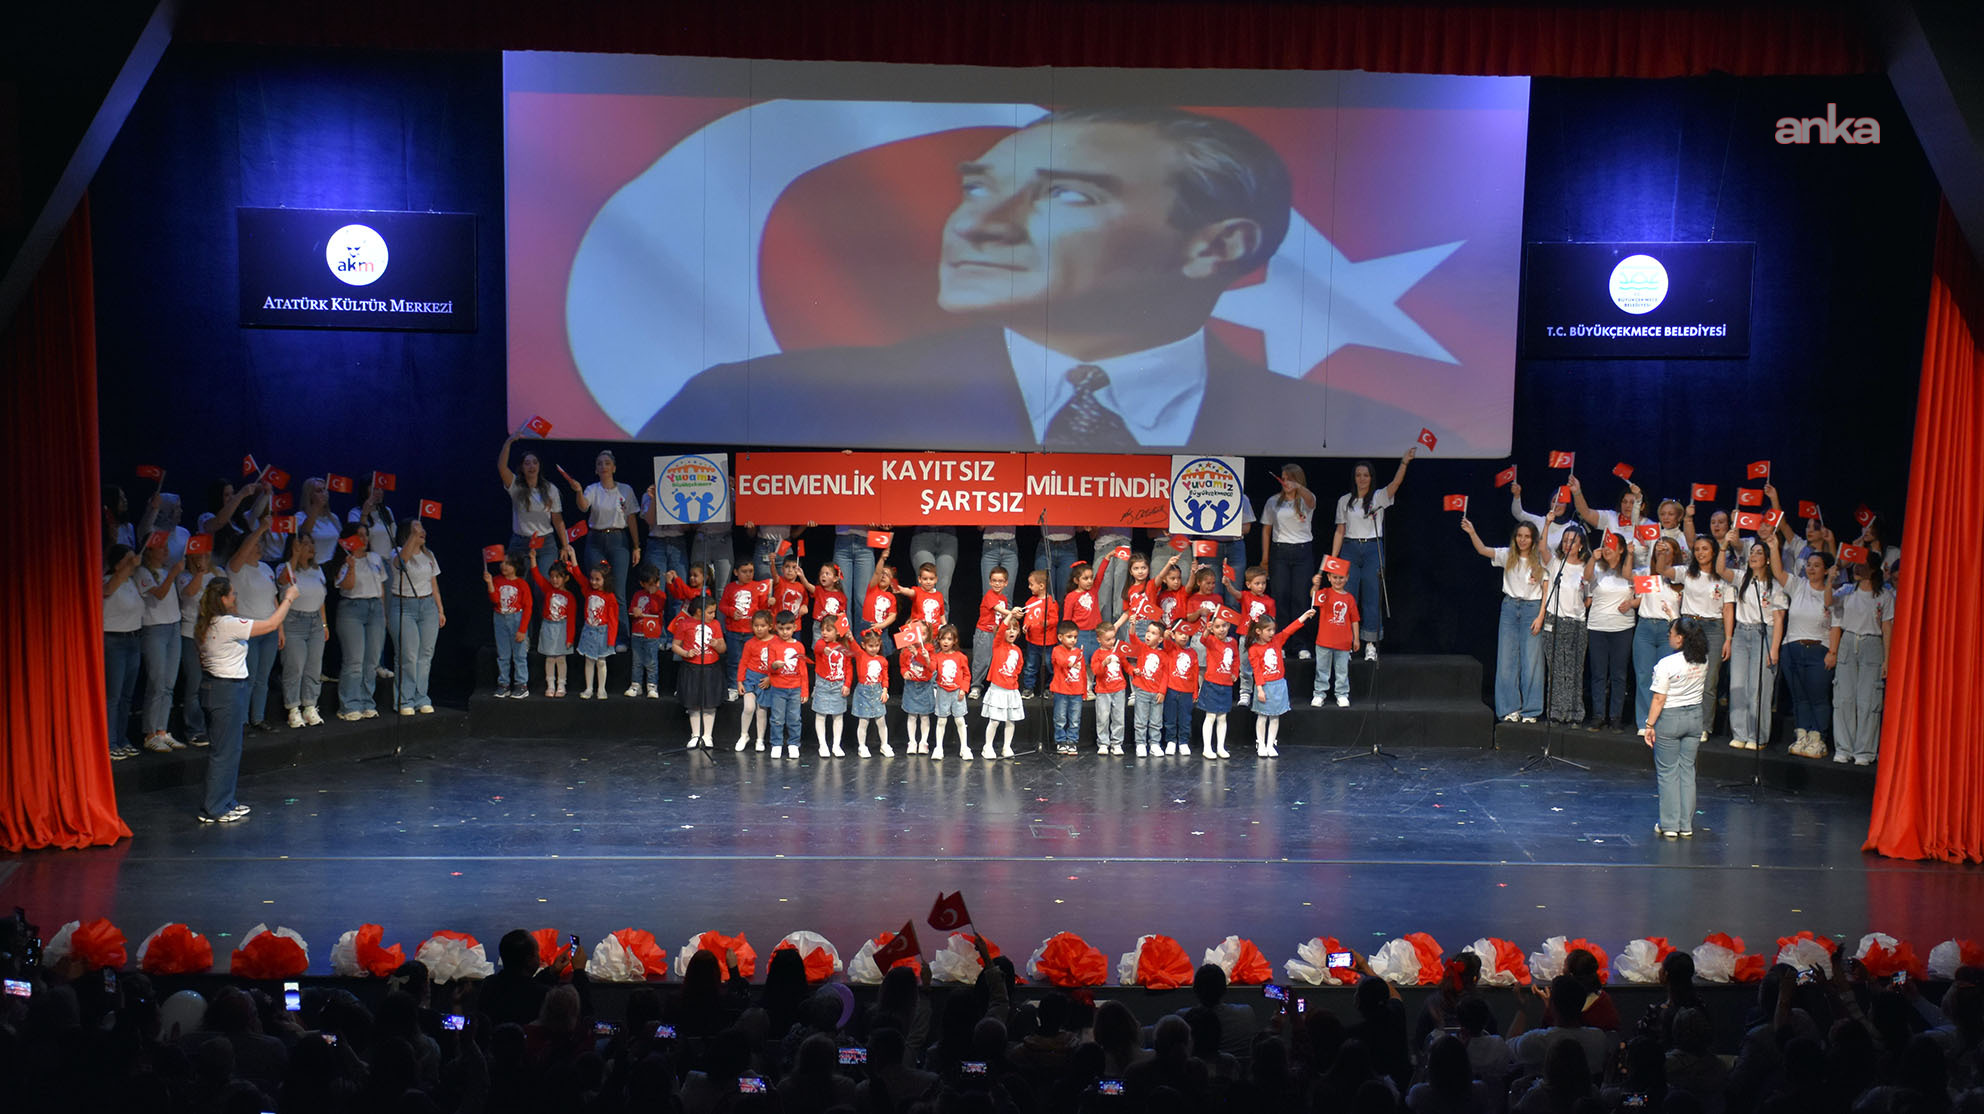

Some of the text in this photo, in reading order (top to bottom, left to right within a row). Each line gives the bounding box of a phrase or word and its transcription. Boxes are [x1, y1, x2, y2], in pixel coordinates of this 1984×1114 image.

[337, 258, 374, 272] akm
[263, 296, 453, 314] ATATÜRK KÜLTÜR MERKEZİ
[1547, 323, 1727, 339] T.C. BÜYÜKÇEKMECE BELEDİYESİ
[882, 460, 995, 481] KAYITSIZ
[739, 470, 875, 496] EGEMENLİK
[1026, 470, 1170, 499] MİLLETİNDİR
[920, 489, 1024, 515] ŞARTSIZ
